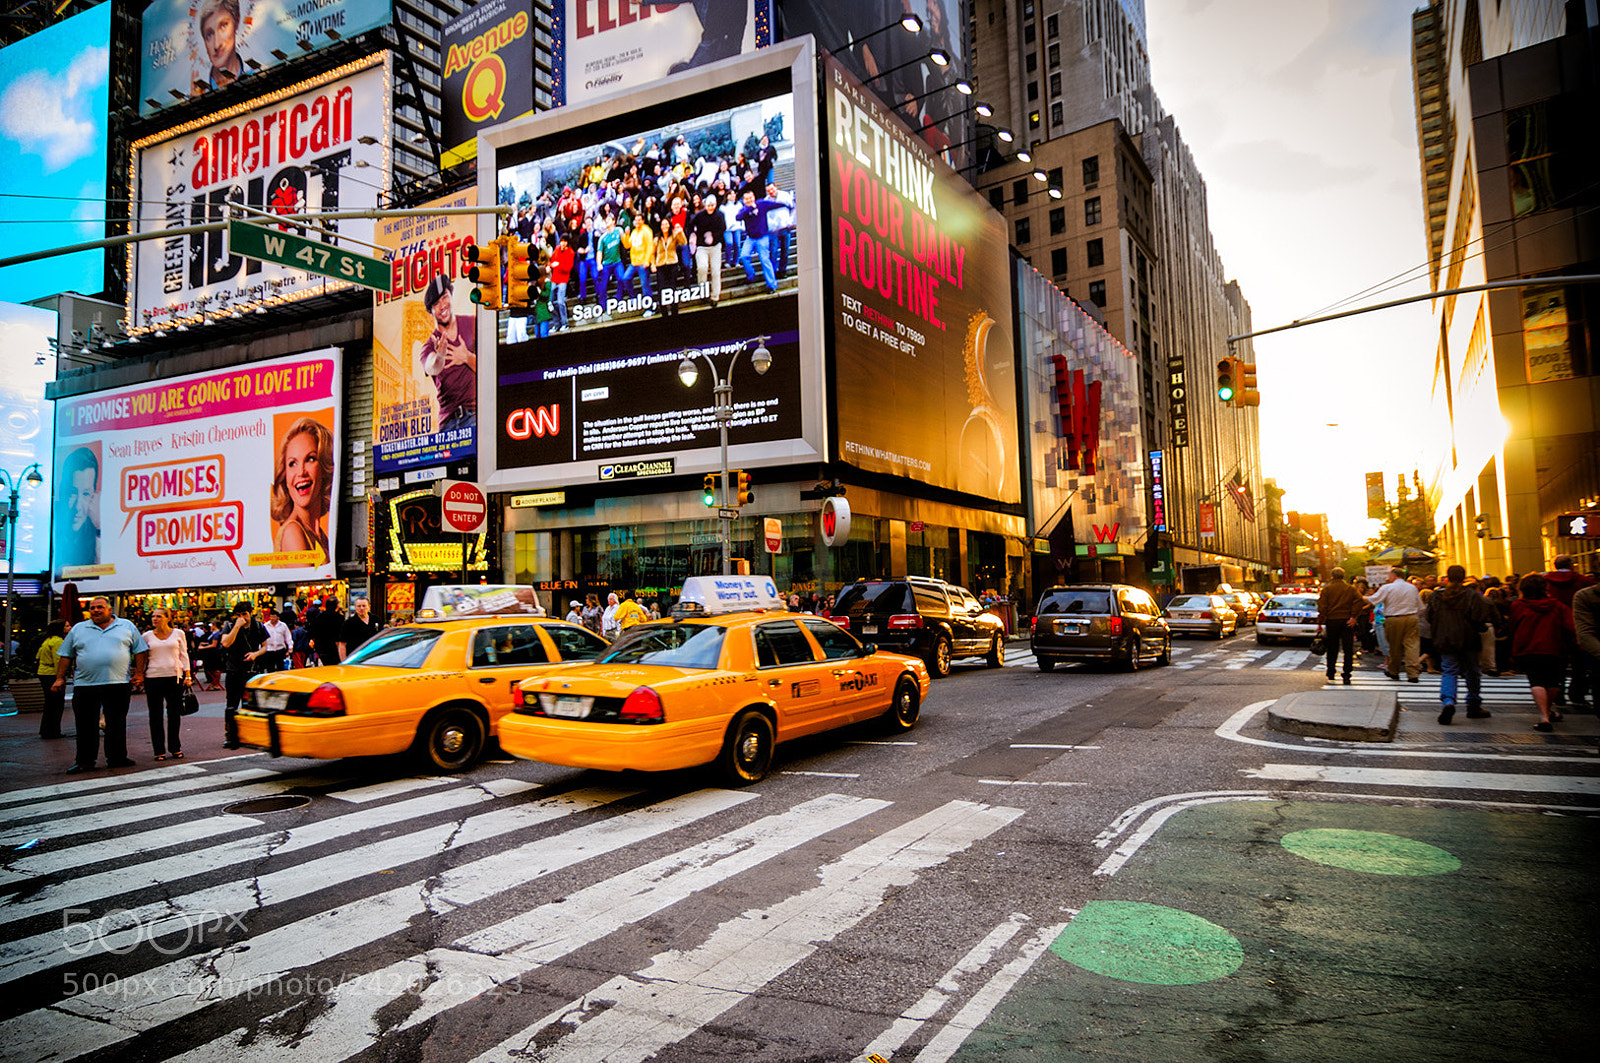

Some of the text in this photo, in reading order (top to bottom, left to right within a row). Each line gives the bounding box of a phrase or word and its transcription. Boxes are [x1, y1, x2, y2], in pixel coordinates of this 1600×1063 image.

[296, 9, 346, 40] SHOWTIME
[461, 3, 507, 35] BEST MUSICAL
[444, 11, 528, 79] Avenue
[463, 53, 505, 122] Q
[834, 68, 935, 168] BARE ESCENTUALS
[191, 85, 353, 190] american
[834, 87, 937, 221] RETHINK
[401, 228, 413, 241] JUST
[415, 223, 426, 236] GOT
[835, 150, 966, 291] YOUR DAILY
[164, 236, 184, 294] GREEN
[264, 234, 286, 258] W
[296, 246, 331, 269] 47
[340, 257, 366, 280] St
[400, 239, 426, 258] THE
[838, 216, 947, 331] ROUTINE.
[572, 281, 710, 322] Sao Paulo, Brazil
[841, 293, 862, 314] TEXT
[863, 305, 895, 331] RETHINK
[896, 321, 906, 336] TO
[842, 312, 854, 328] TO
[855, 321, 871, 338] GET
[873, 329, 880, 340] A
[880, 332, 899, 349] FREE
[543, 369, 556, 380] For
[556, 366, 578, 378] Audio
[578, 363, 593, 375] Dial
[702, 346, 719, 357] may
[78, 397, 130, 427] PROMISE
[131, 393, 156, 416] YOU
[158, 387, 185, 412] ARE
[188, 378, 230, 407] GOING
[233, 374, 251, 398] TO
[255, 368, 292, 396] LOVE
[702, 406, 714, 414] and
[733, 402, 750, 411] there
[766, 398, 779, 406] end
[1171, 372, 1187, 446] HOTEL
[108, 418, 266, 458] Sean Hayes Kristin Chenoweth
[380, 416, 432, 442] CORBIN BLEU
[506, 403, 560, 440] CNN
[602, 425, 628, 434] Anderson
[681, 415, 701, 425] tonight
[731, 418, 752, 427] tonight
[128, 465, 219, 502] PROMISES,
[450, 490, 478, 501] DO NOT
[145, 512, 235, 547] PROMISES
[452, 513, 477, 523] ENTER
[823, 512, 836, 537] W
[1093, 523, 1119, 543] W
[146, 556, 216, 572] The Musical Comedy
[412, 550, 464, 559] DELICATESSE
[1057, 557, 1073, 569] W
[540, 581, 562, 590] BLUE
[715, 581, 742, 590] Money
[716, 591, 741, 600] Worry
[791, 582, 816, 592] DINNER
